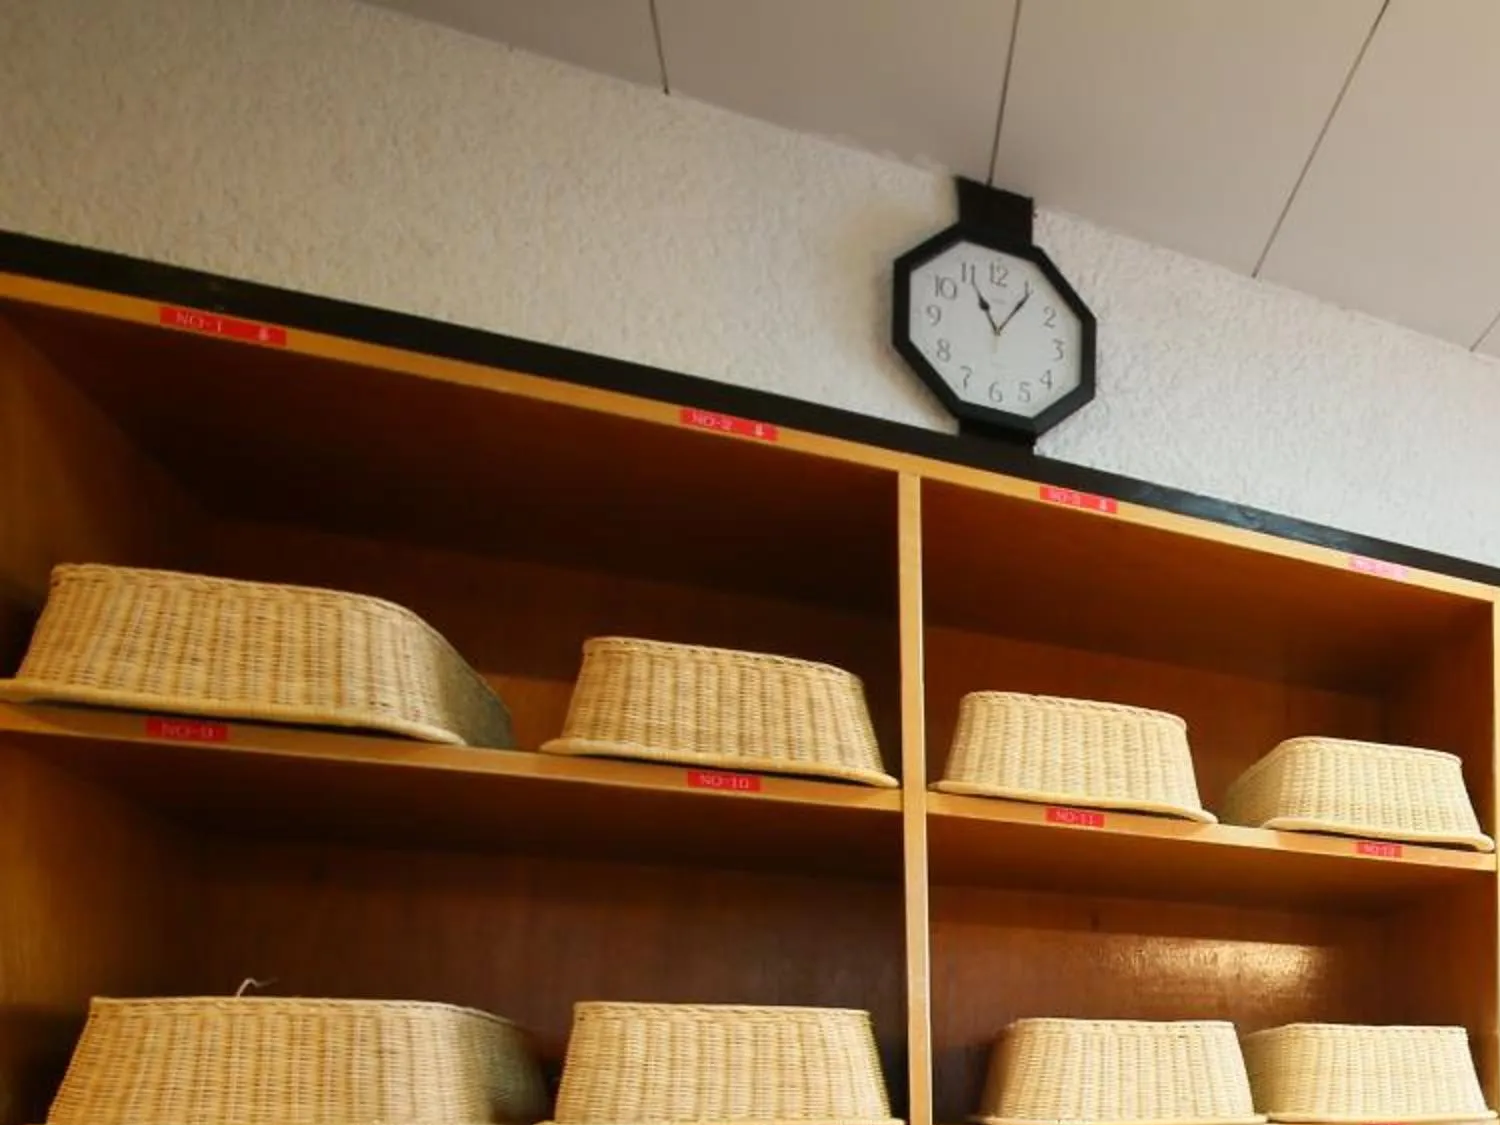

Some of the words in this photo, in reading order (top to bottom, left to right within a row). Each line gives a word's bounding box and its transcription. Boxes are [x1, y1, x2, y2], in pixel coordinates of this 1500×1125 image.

[961, 262, 976, 284] 11
[989, 262, 1008, 287] 12
[934, 275, 957, 300] 10
[926, 305, 942, 326] 9
[1043, 306, 1057, 328] 2
[936, 338, 951, 363] 8
[1051, 338, 1065, 361] 3
[960, 366, 973, 389] 7
[1039, 369, 1053, 390] 4
[989, 381, 1003, 403] 6
[1018, 381, 1031, 403] 5
[699, 773, 749, 790] NO-10
